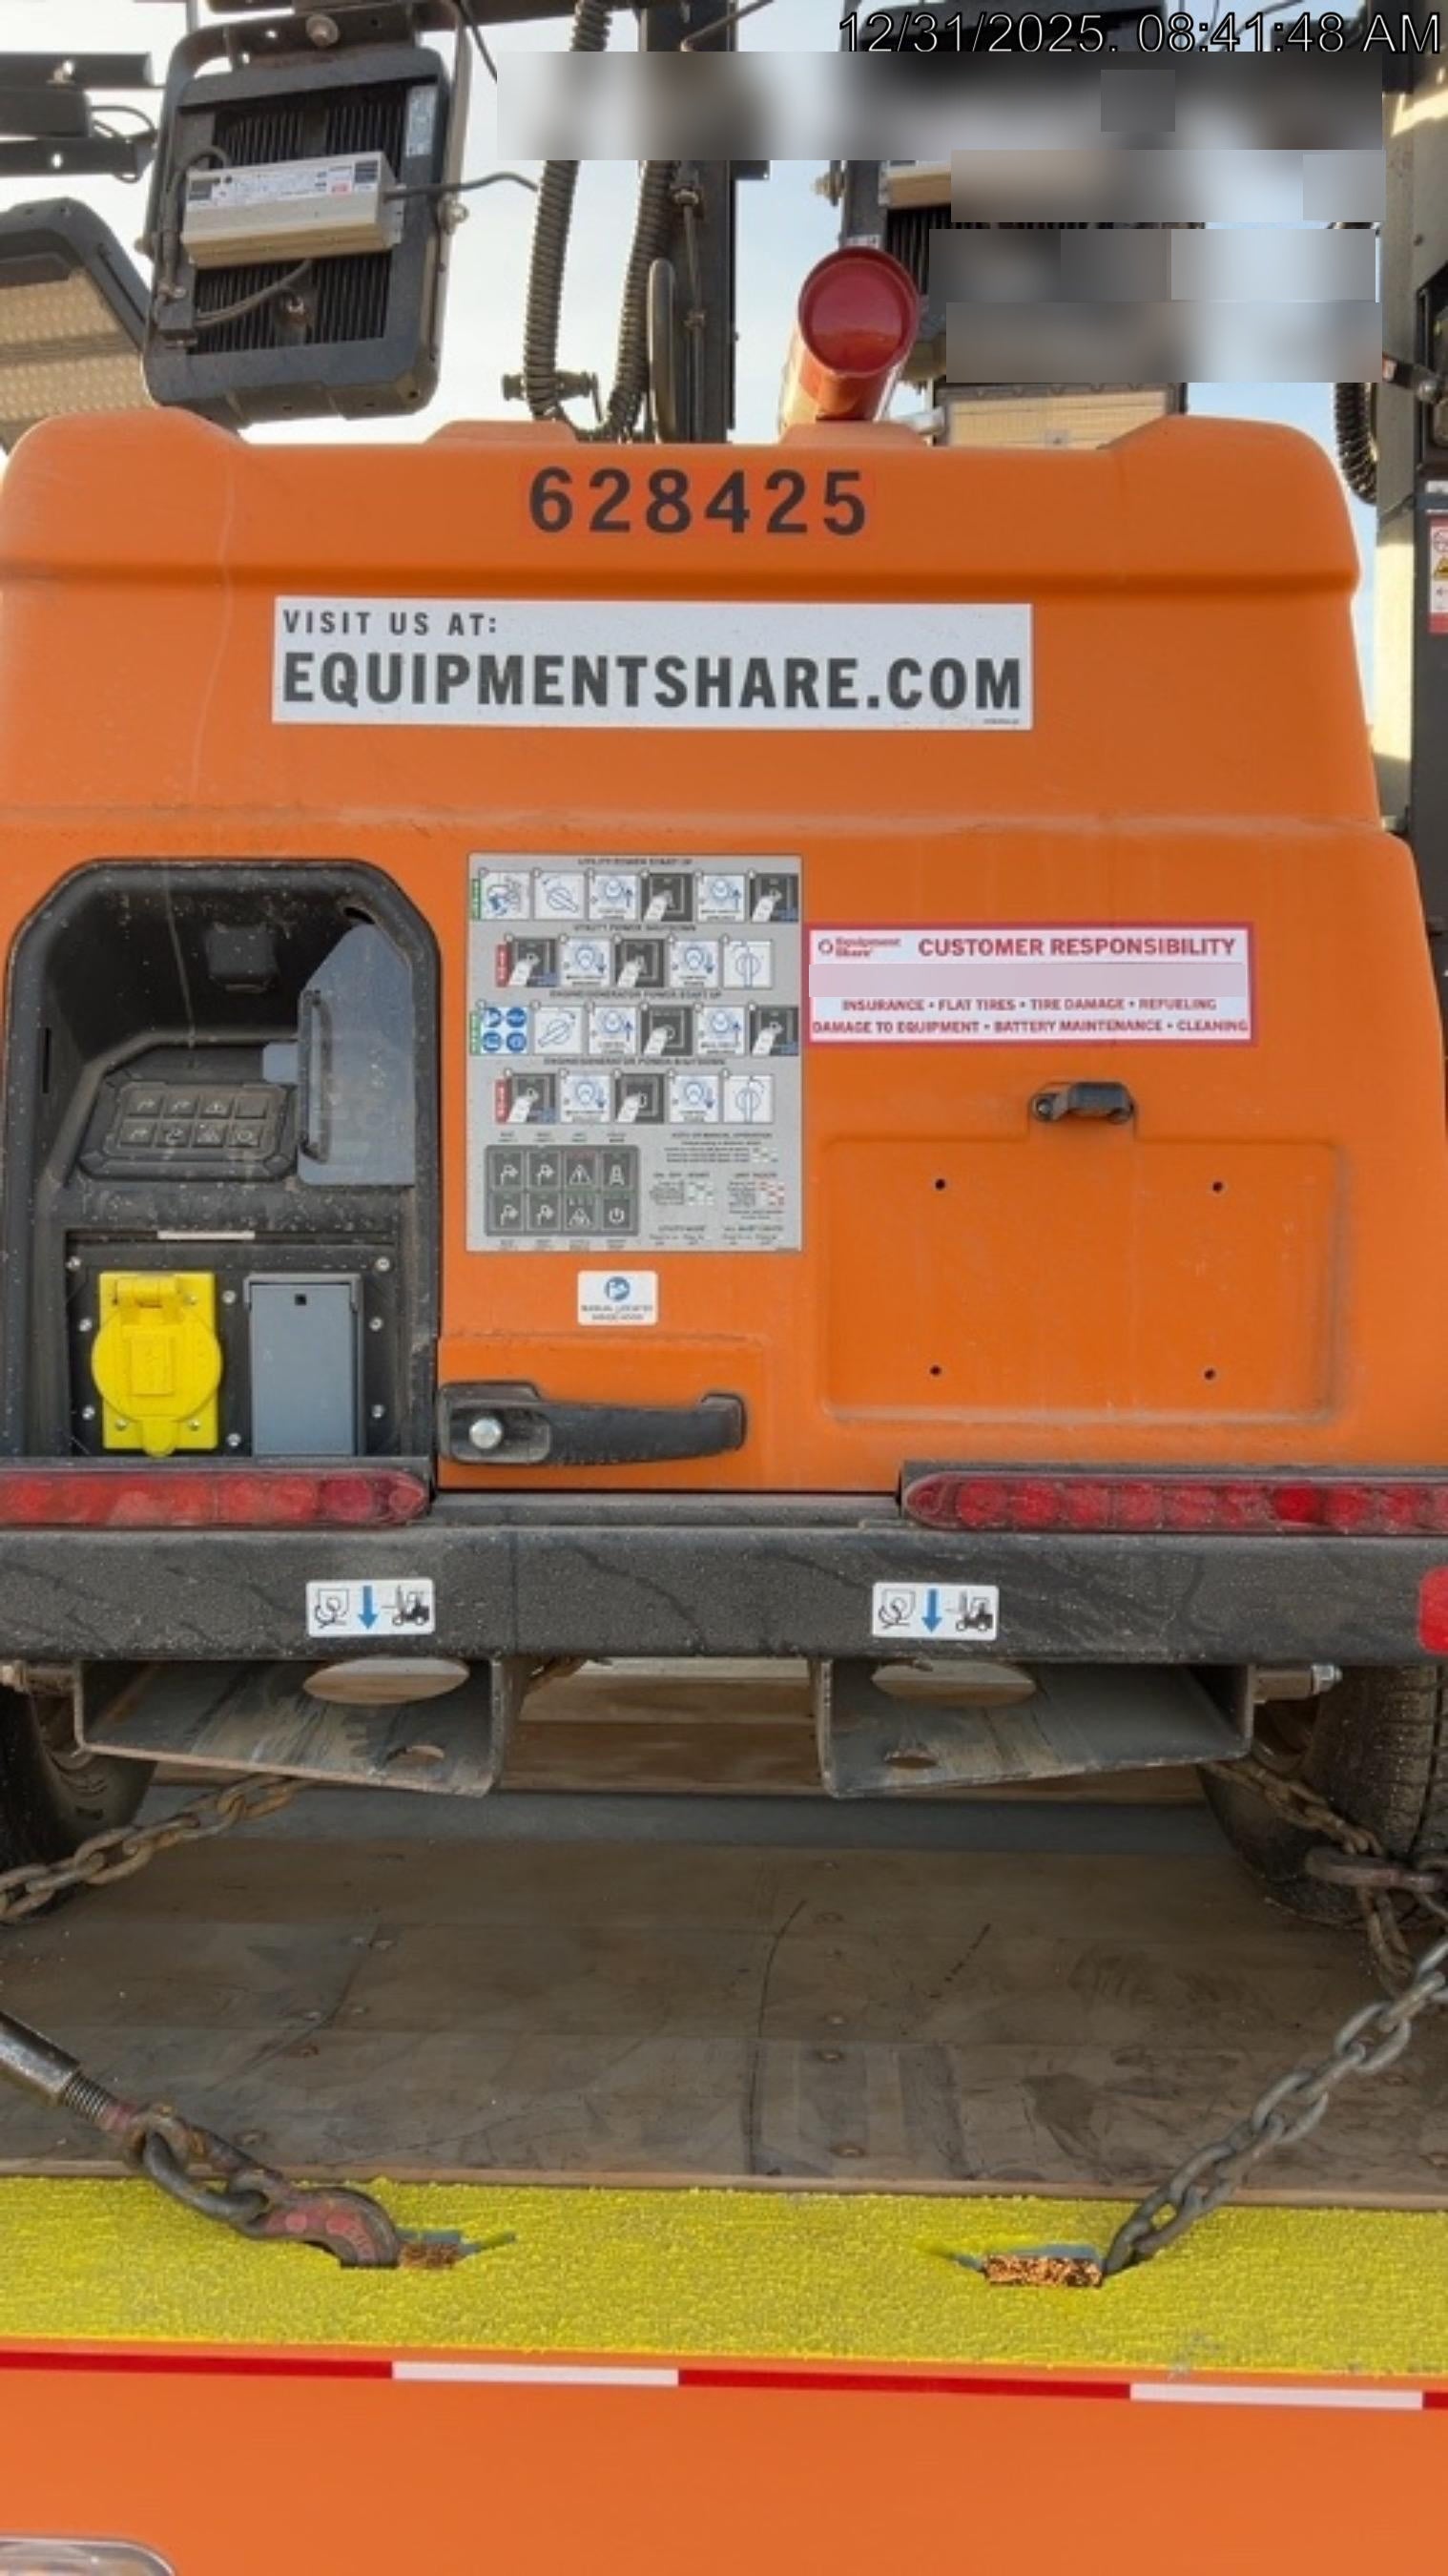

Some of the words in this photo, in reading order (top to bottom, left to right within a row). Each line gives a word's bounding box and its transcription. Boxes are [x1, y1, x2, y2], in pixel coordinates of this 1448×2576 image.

[529, 467, 866, 535] 628425
[283, 610, 370, 635] VISIT
[390, 612, 429, 636] US
[447, 612, 496, 636] AT:
[283, 652, 1020, 710] EQUIPMENTSHARE.COM
[919, 939, 1044, 956] CUSTOMER
[1051, 939, 1235, 955] RESPONSIBILITY
[842, 999, 924, 1011] INSURANCE
[939, 999, 971, 1011] FLAT
[977, 999, 1016, 1011] TIRES
[1031, 999, 1061, 1010] TIRE
[1065, 999, 1125, 1010] DAMAGE
[1139, 999, 1217, 1010] REFUELING
[813, 1021, 871, 1033] DAMAGE
[877, 1021, 893, 1033] TO
[898, 1021, 980, 1033] EQUIPMENT
[994, 1021, 1056, 1032] BATTERY
[1059, 1019, 1163, 1031] MAINTENANCE
[1176, 1018, 1249, 1031] CLEANING
